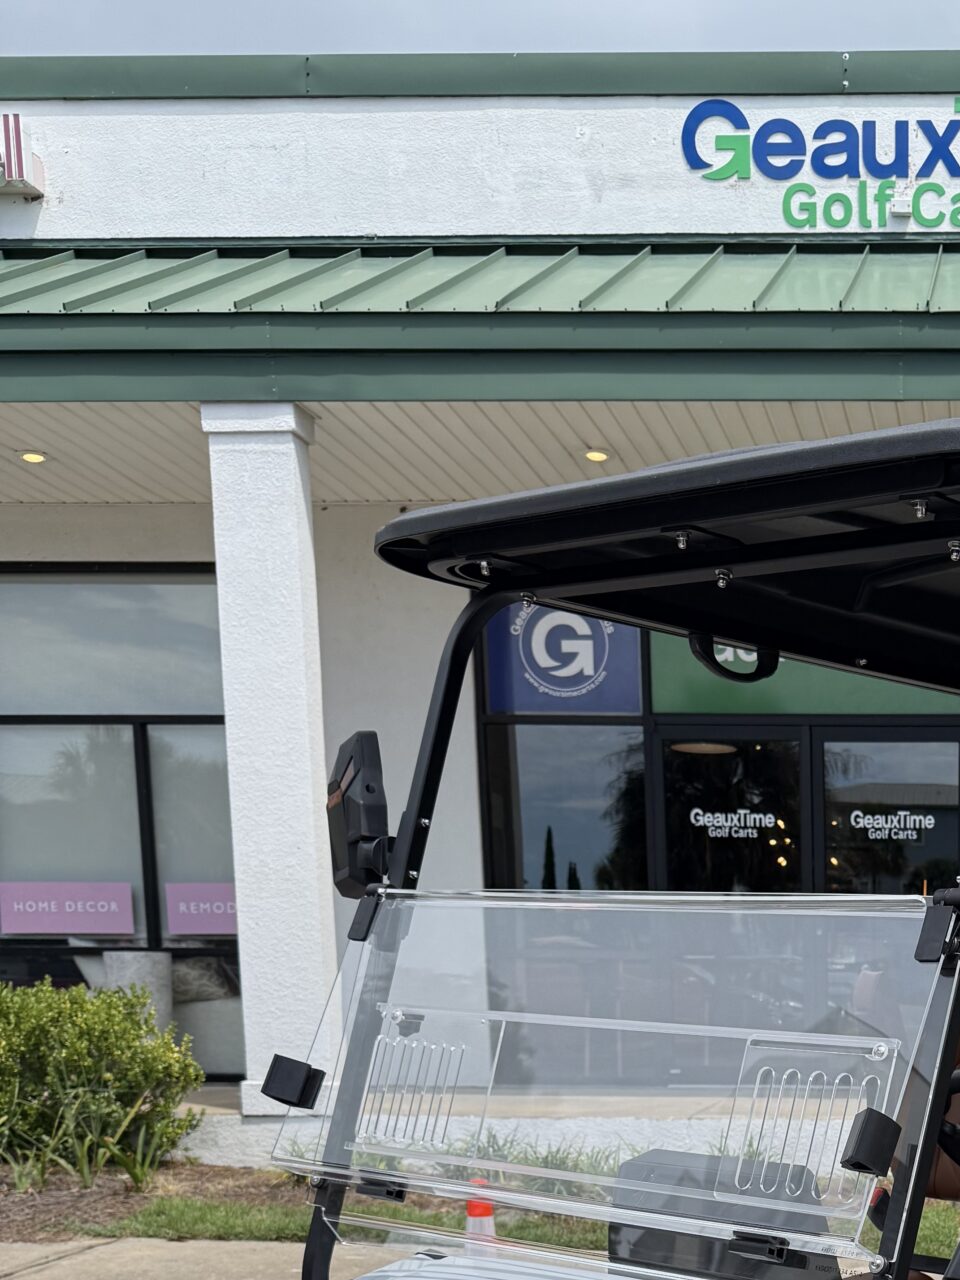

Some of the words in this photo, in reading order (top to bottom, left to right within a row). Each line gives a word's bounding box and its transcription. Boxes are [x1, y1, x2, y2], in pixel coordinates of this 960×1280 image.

[782, 180, 895, 229] Golf
[690, 808, 776, 828] GeauxTime
[850, 810, 936, 830] GeauxTime
[708, 826, 730, 838] Golf
[731, 827, 758, 838] Carts
[868, 828, 890, 840] Golf
[891, 829, 918, 840] Carts
[13, 901, 58, 913] HOME
[65, 901, 119, 913] DECOR
[179, 902, 236, 914] REMOD
